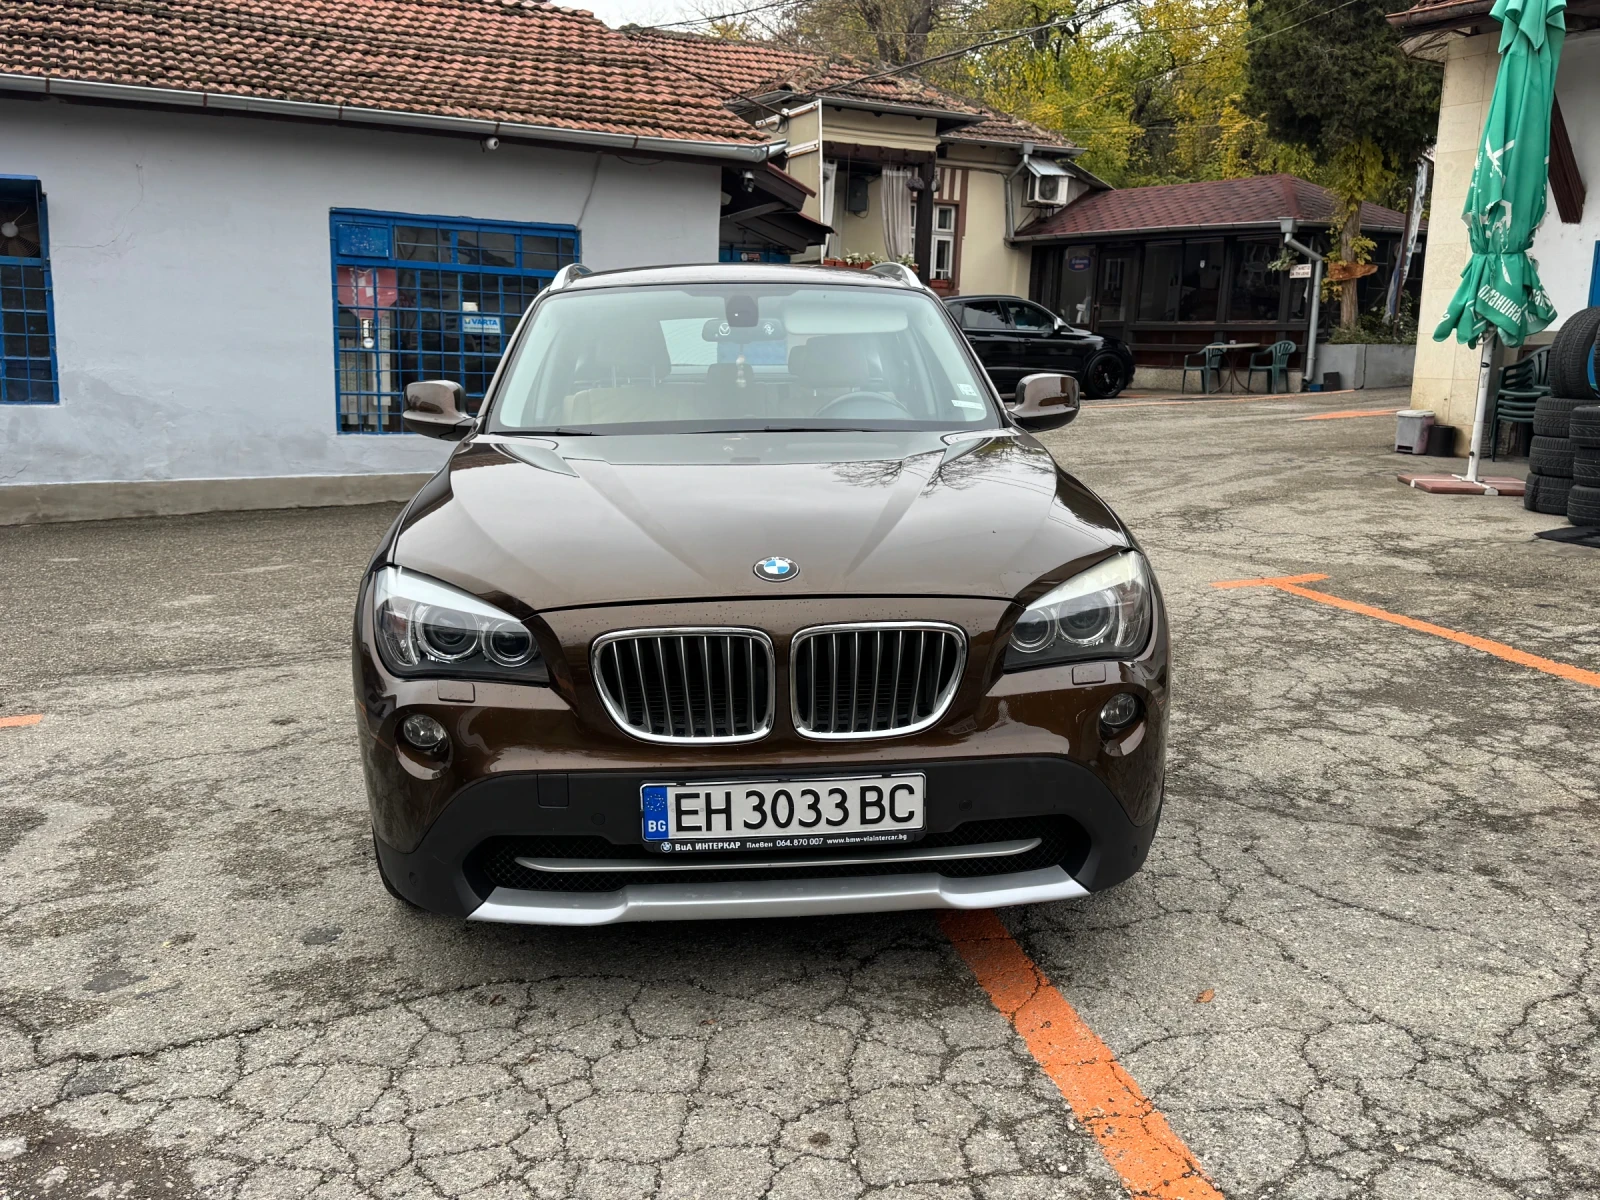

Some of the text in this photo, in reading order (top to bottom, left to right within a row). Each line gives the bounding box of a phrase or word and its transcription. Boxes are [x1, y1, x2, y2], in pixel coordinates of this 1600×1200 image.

[471, 318, 498, 326] VARTA
[648, 820, 667, 832] BG
[695, 841, 741, 850] ИНТЕРКАР
